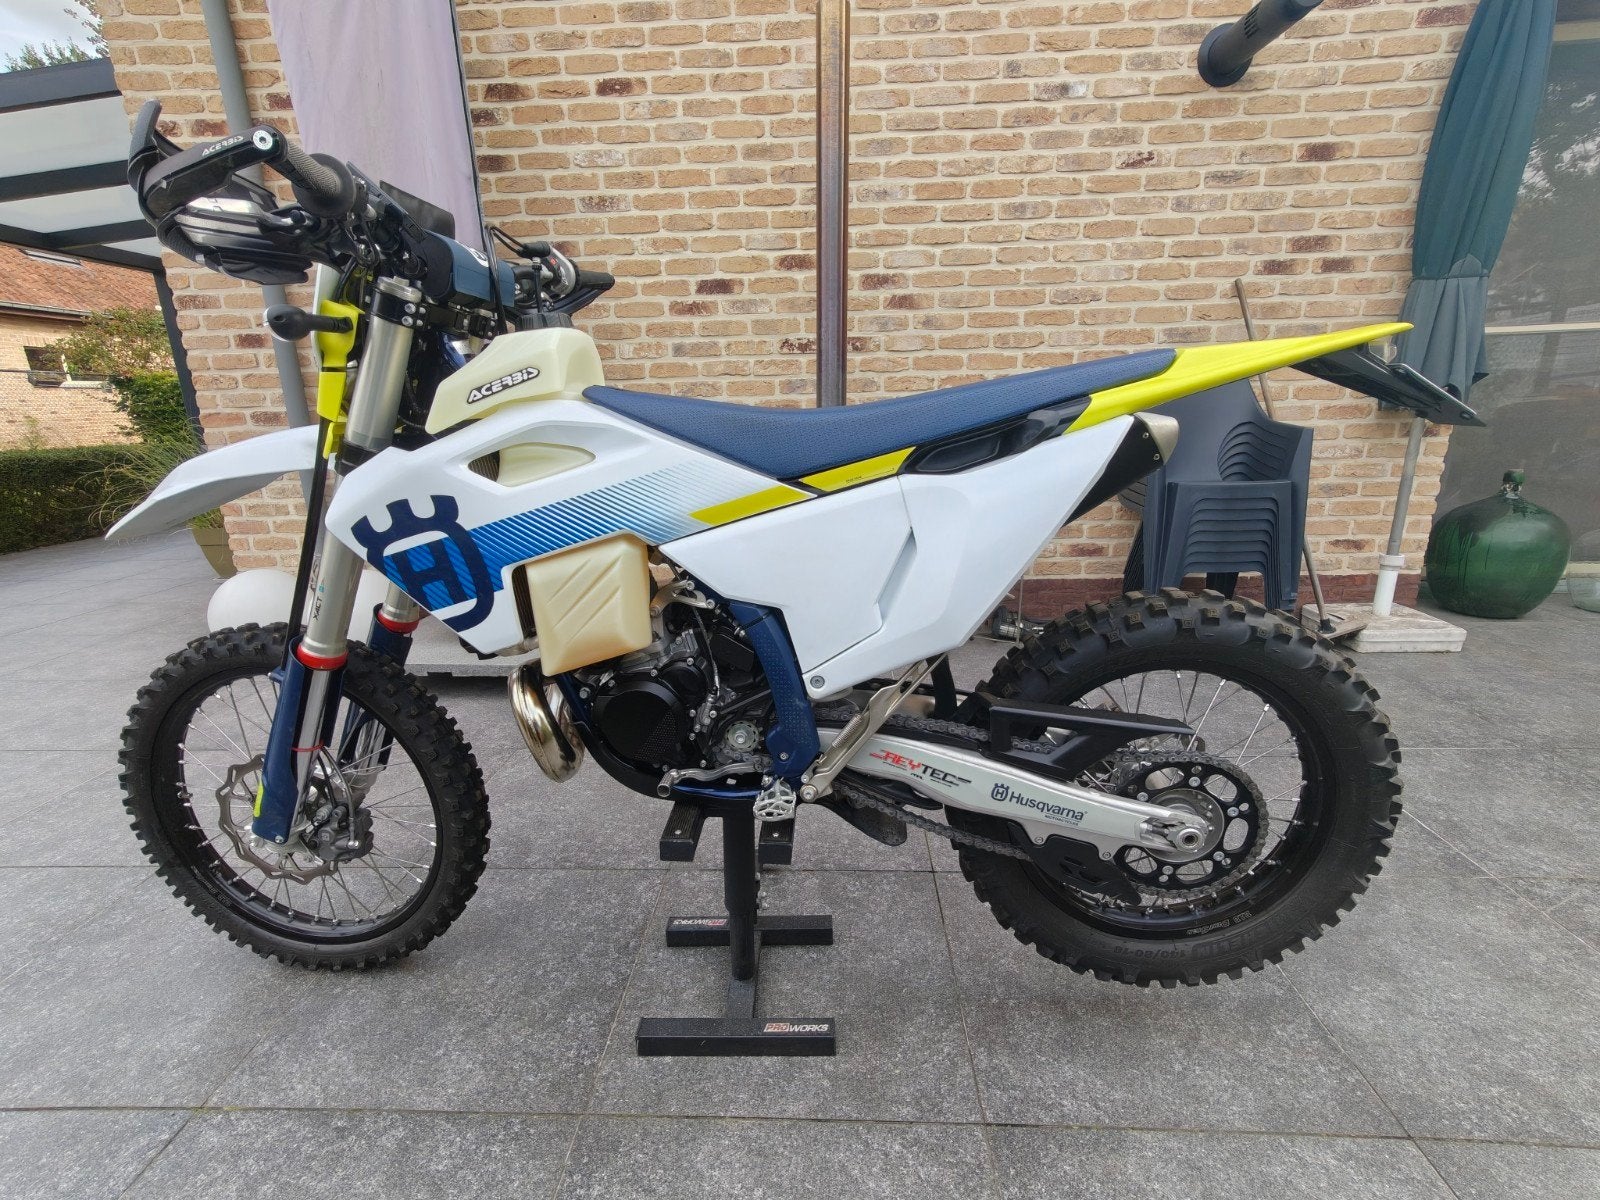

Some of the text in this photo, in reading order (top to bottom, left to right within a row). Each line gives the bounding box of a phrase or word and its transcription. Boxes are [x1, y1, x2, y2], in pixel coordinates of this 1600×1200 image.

[313, 596, 323, 621] XACT
[870, 750, 971, 787] REYTEC
[1010, 791, 1084, 821] Husqvarna
